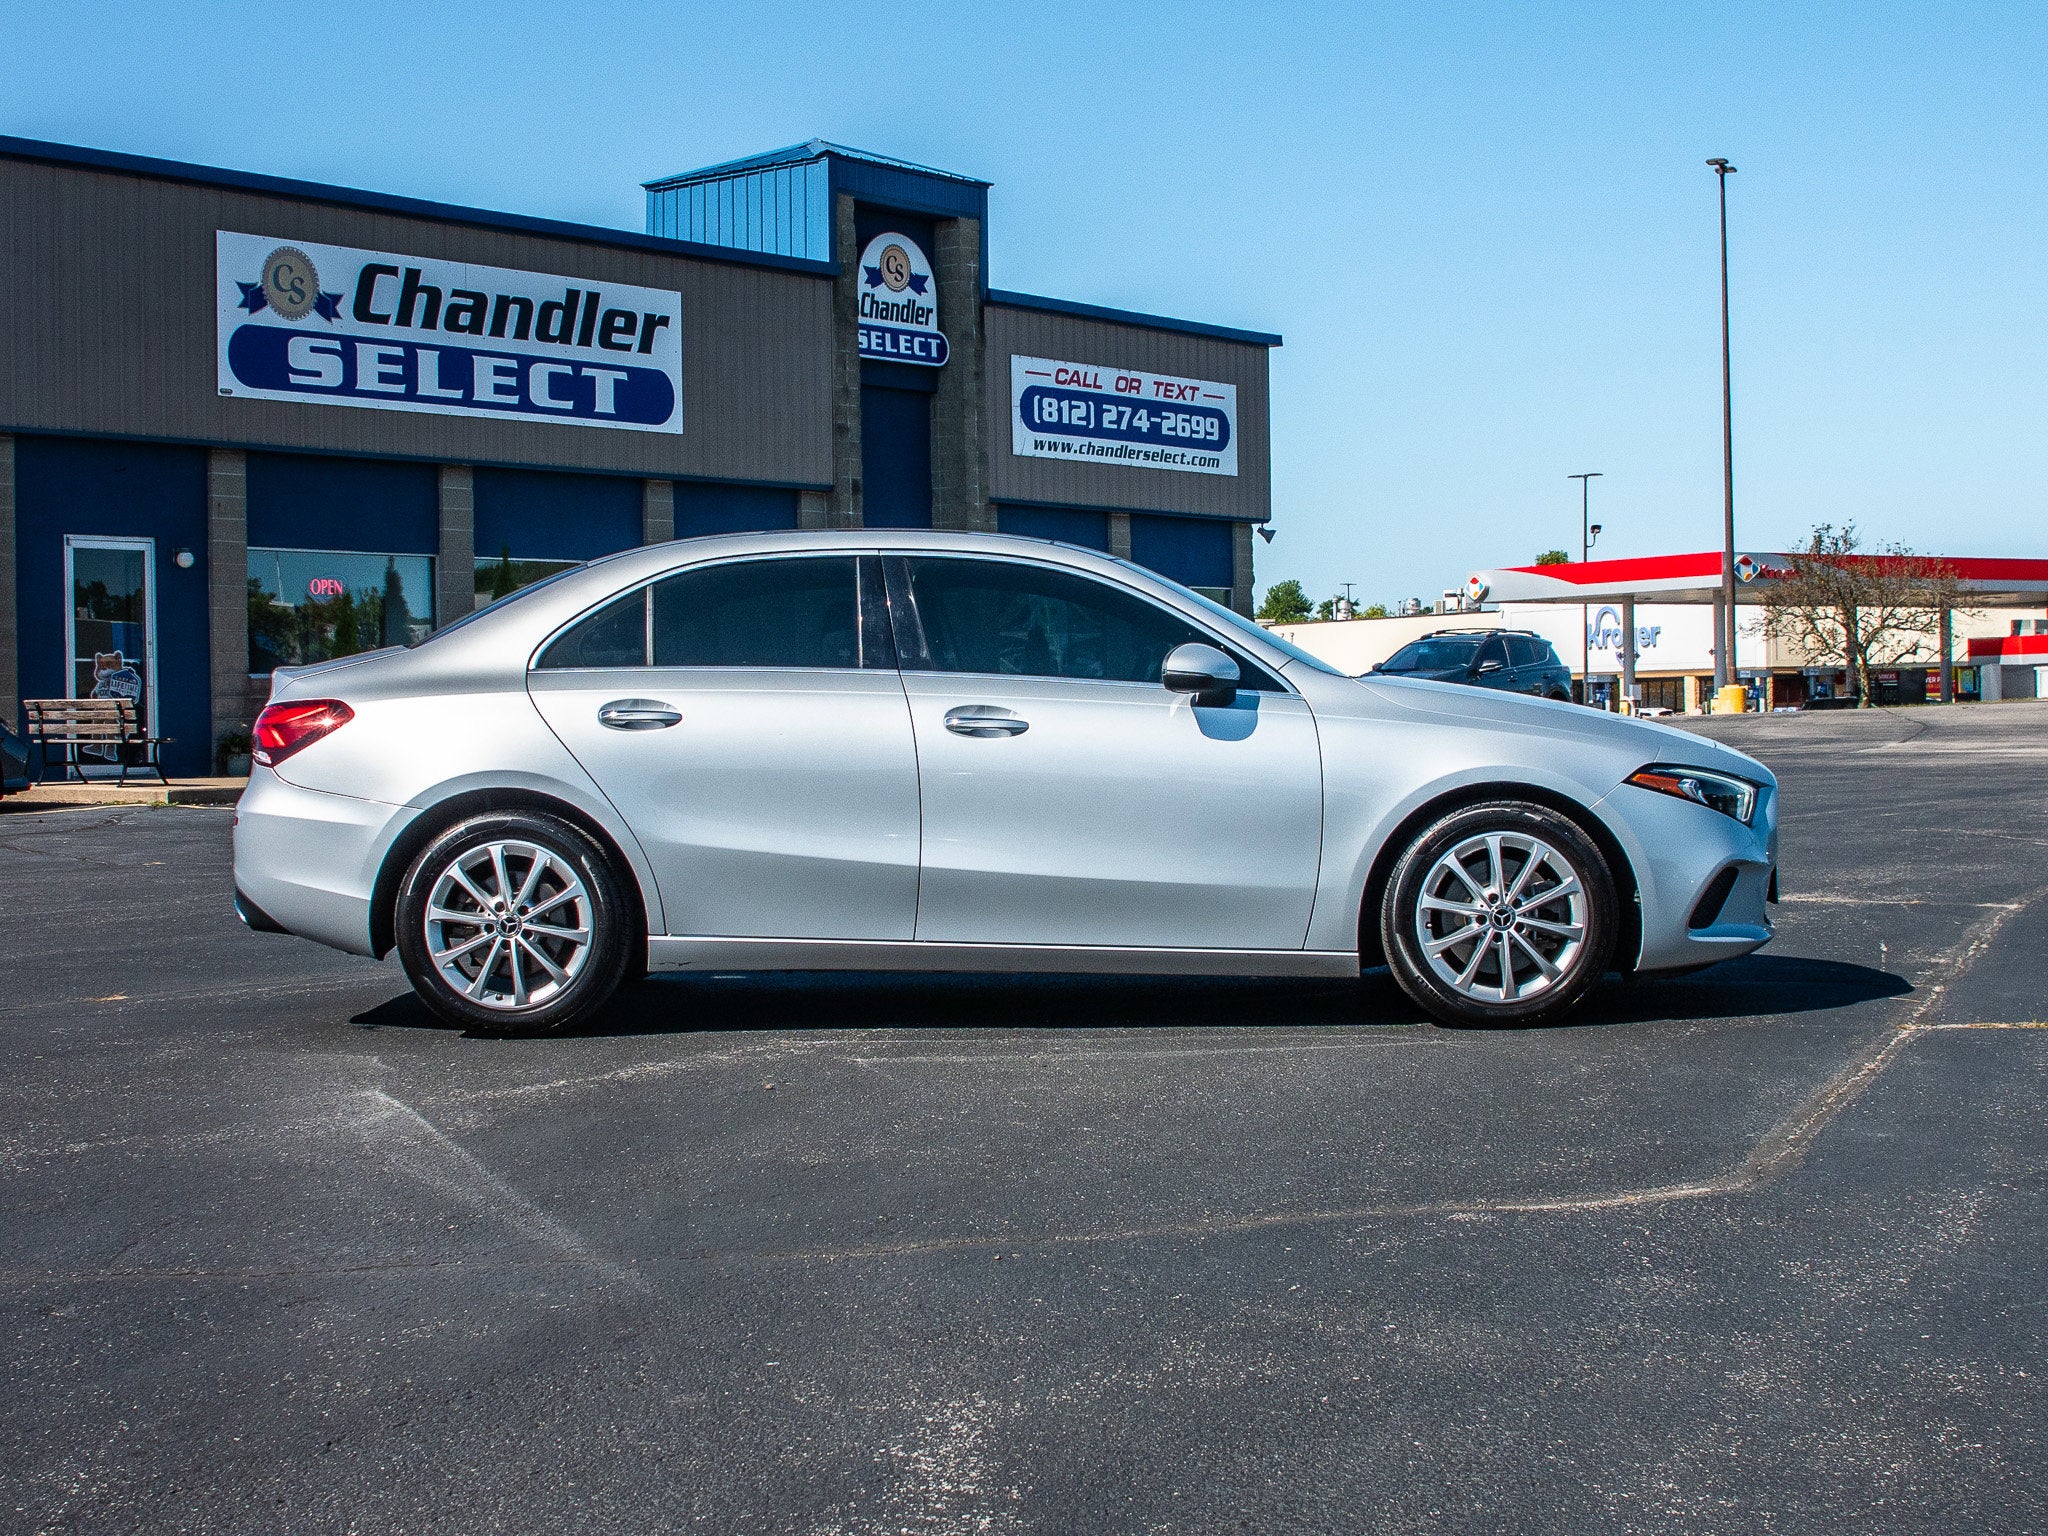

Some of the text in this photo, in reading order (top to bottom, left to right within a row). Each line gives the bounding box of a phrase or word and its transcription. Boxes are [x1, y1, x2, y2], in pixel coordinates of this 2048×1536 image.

[352, 262, 670, 355] Chandler
[860, 291, 933, 326] Chandler
[858, 329, 941, 358] SELECT
[287, 335, 629, 414] SELECT
[1055, 368, 1200, 402] CALL OR TEXT
[1033, 394, 1219, 441] (812) 274-2699
[1033, 438, 1220, 469] www.chandlerselect.com
[309, 578, 343, 595] OPEN
[111, 680, 138, 693] LIFETIME
